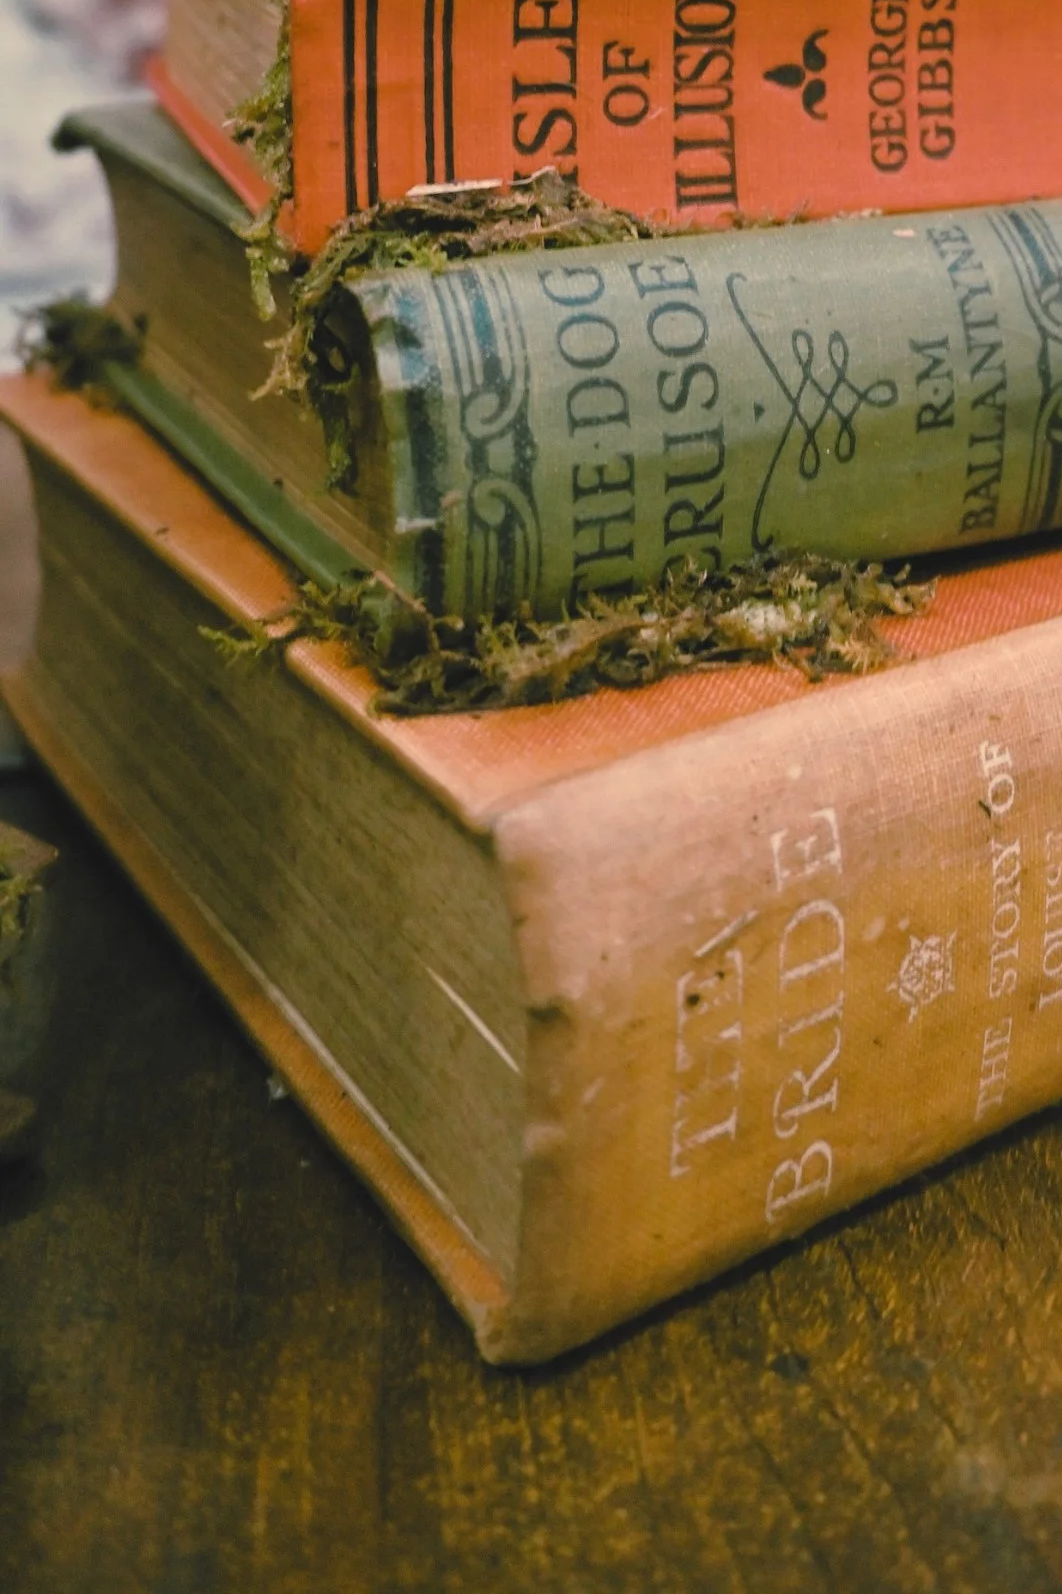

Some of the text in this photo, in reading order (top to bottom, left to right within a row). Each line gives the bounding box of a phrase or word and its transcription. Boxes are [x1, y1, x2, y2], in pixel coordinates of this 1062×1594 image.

[602, 40, 650, 127] OF
[928, 222, 1006, 536] BALLANTYNE
[766, 808, 845, 1225] BRIDE
[975, 741, 1021, 1121] THE STORY OF
